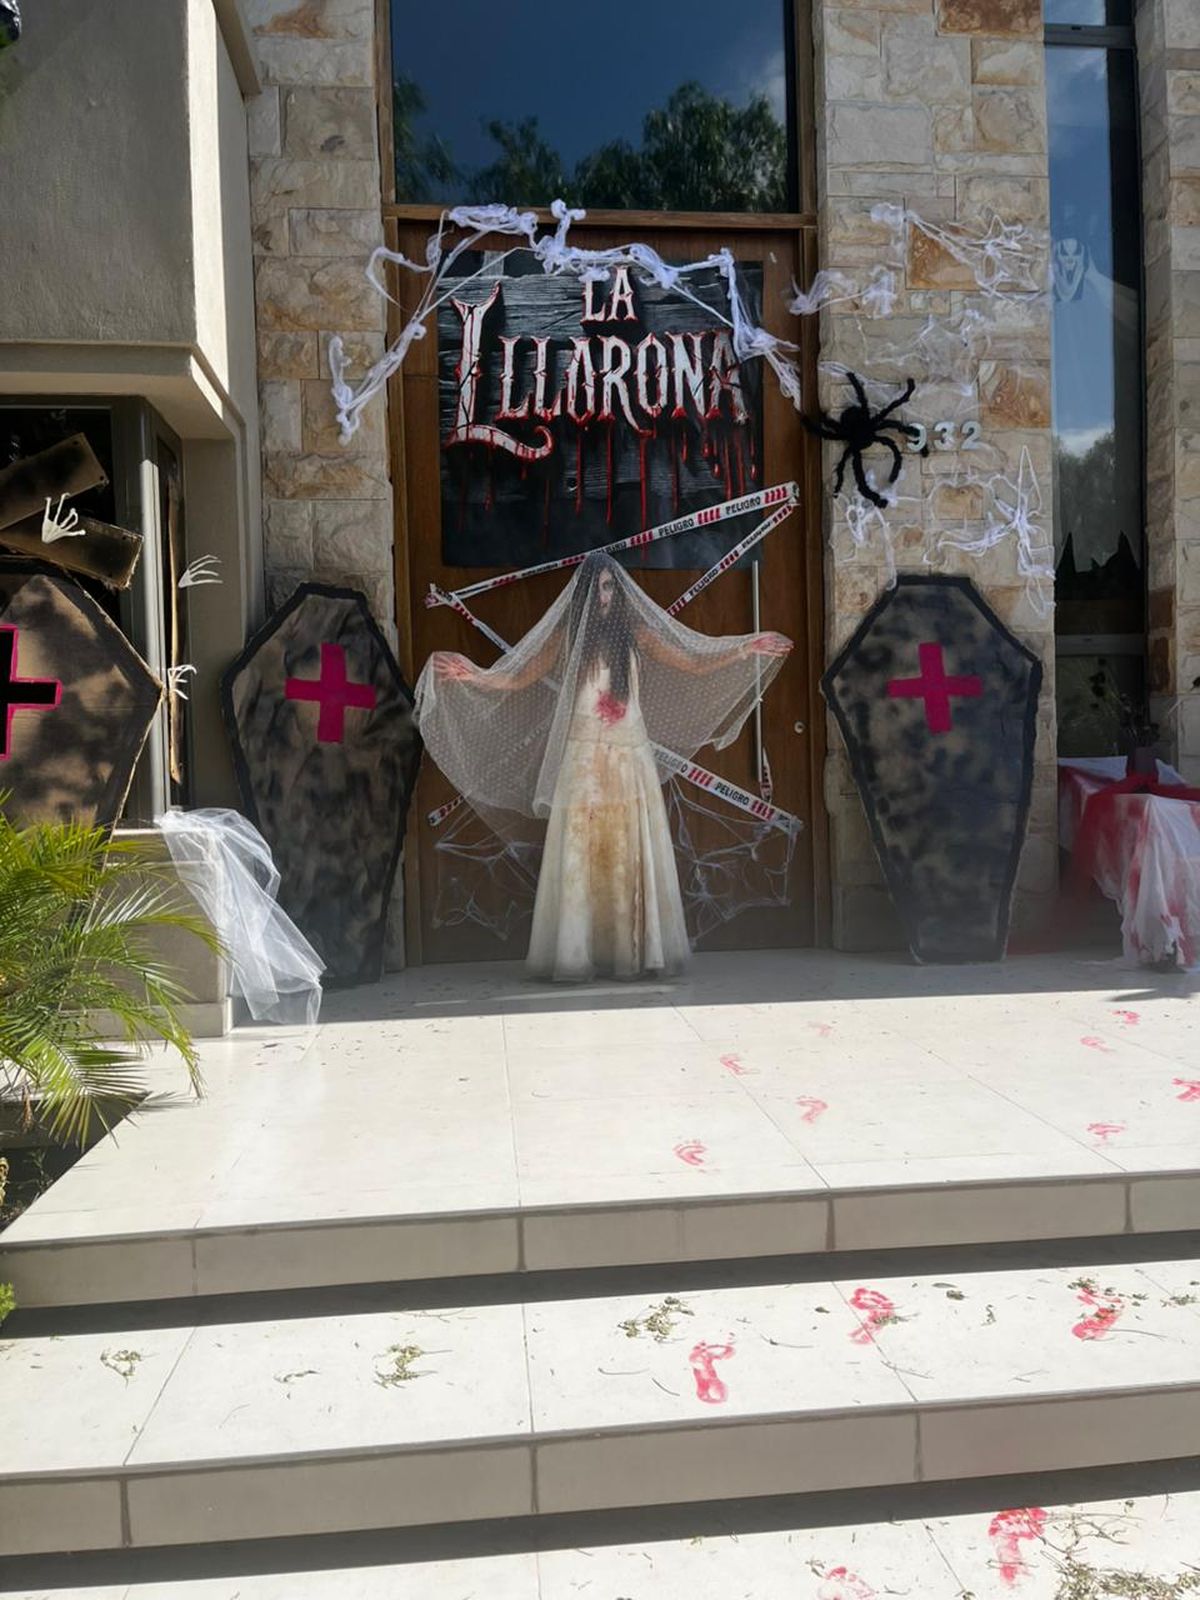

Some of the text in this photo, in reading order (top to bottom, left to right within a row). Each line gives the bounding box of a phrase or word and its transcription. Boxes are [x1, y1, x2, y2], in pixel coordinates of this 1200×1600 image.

[580, 265, 638, 323] LA
[658, 496, 762, 537] PELIGRO PELIGRO
[714, 781, 750, 806] PELIGRO
